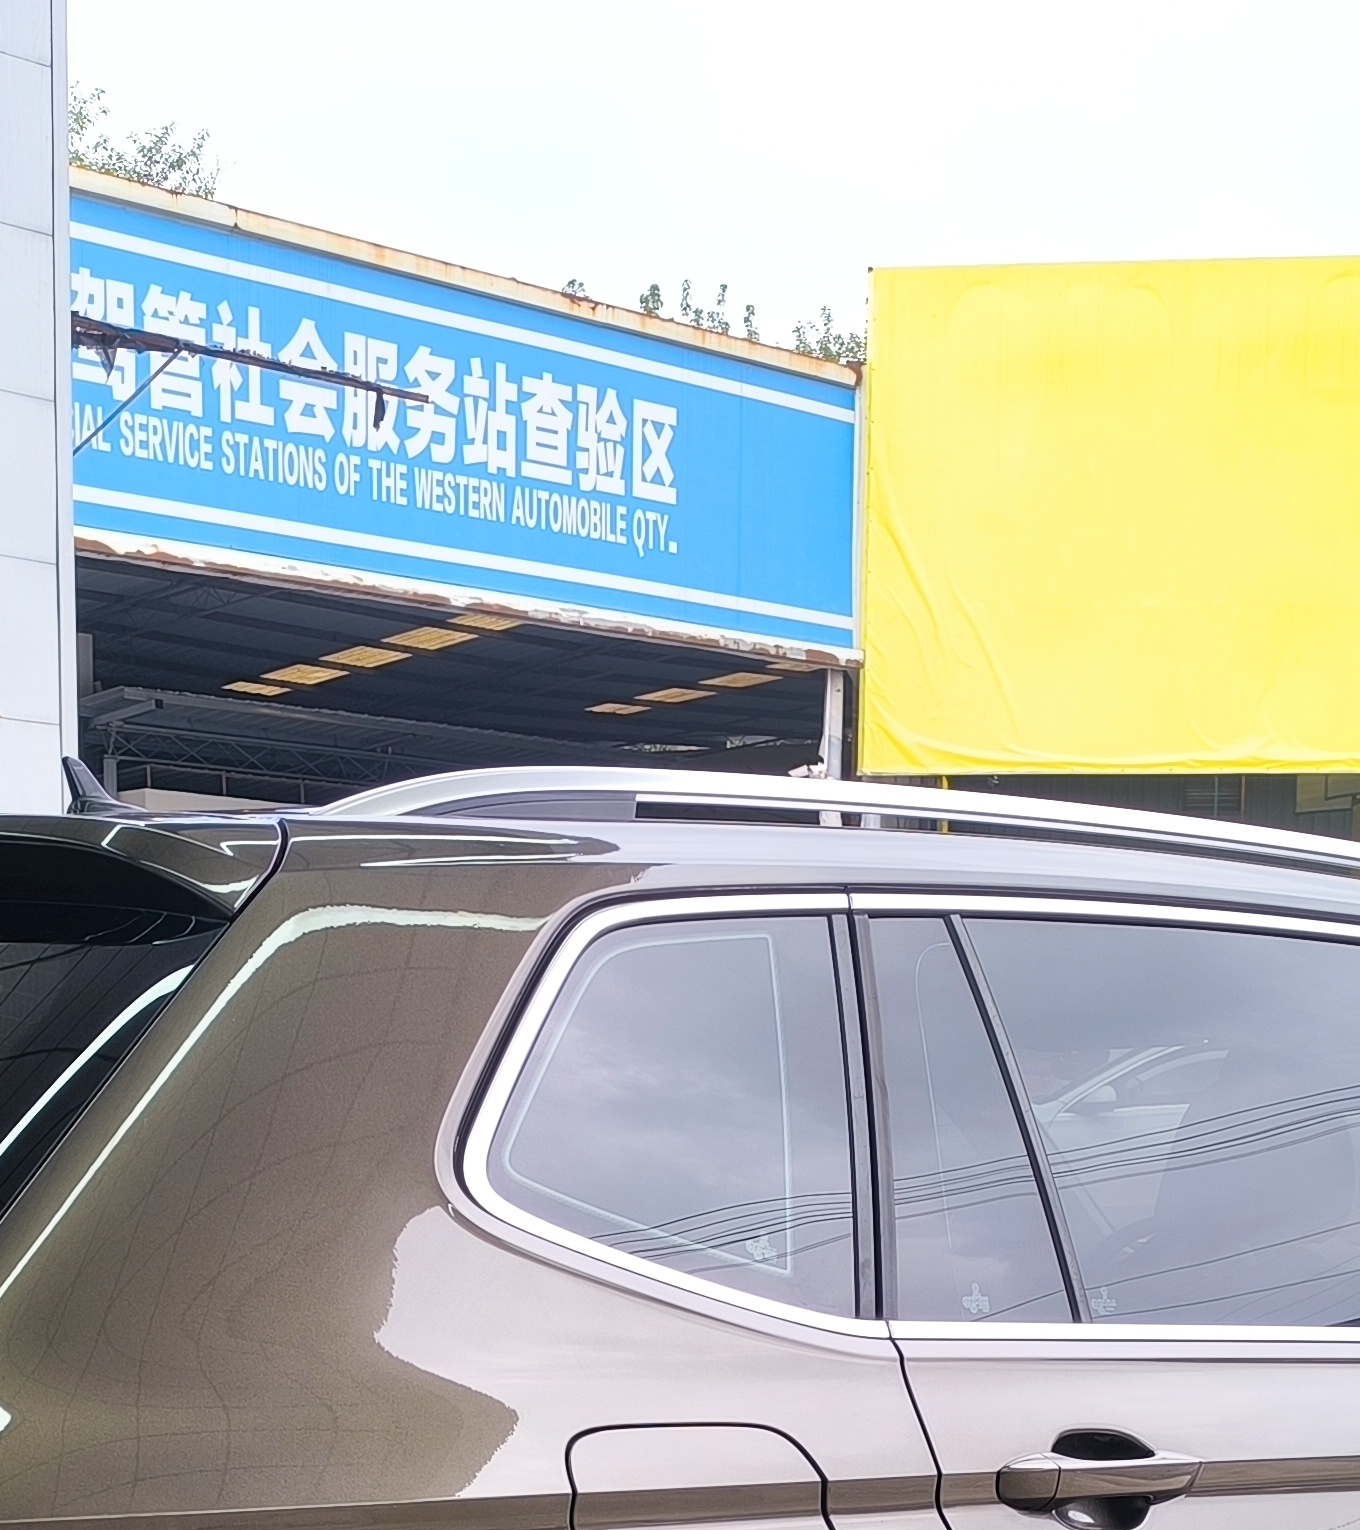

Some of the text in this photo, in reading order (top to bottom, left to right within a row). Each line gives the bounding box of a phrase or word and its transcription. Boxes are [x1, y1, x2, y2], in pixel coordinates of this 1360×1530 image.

[71, 267, 678, 505] 驾管社会服务站查验区
[71, 402, 679, 558] IAL SERVICE STATIONS OF THE WESTERN AUTOMOBILE QTY.
